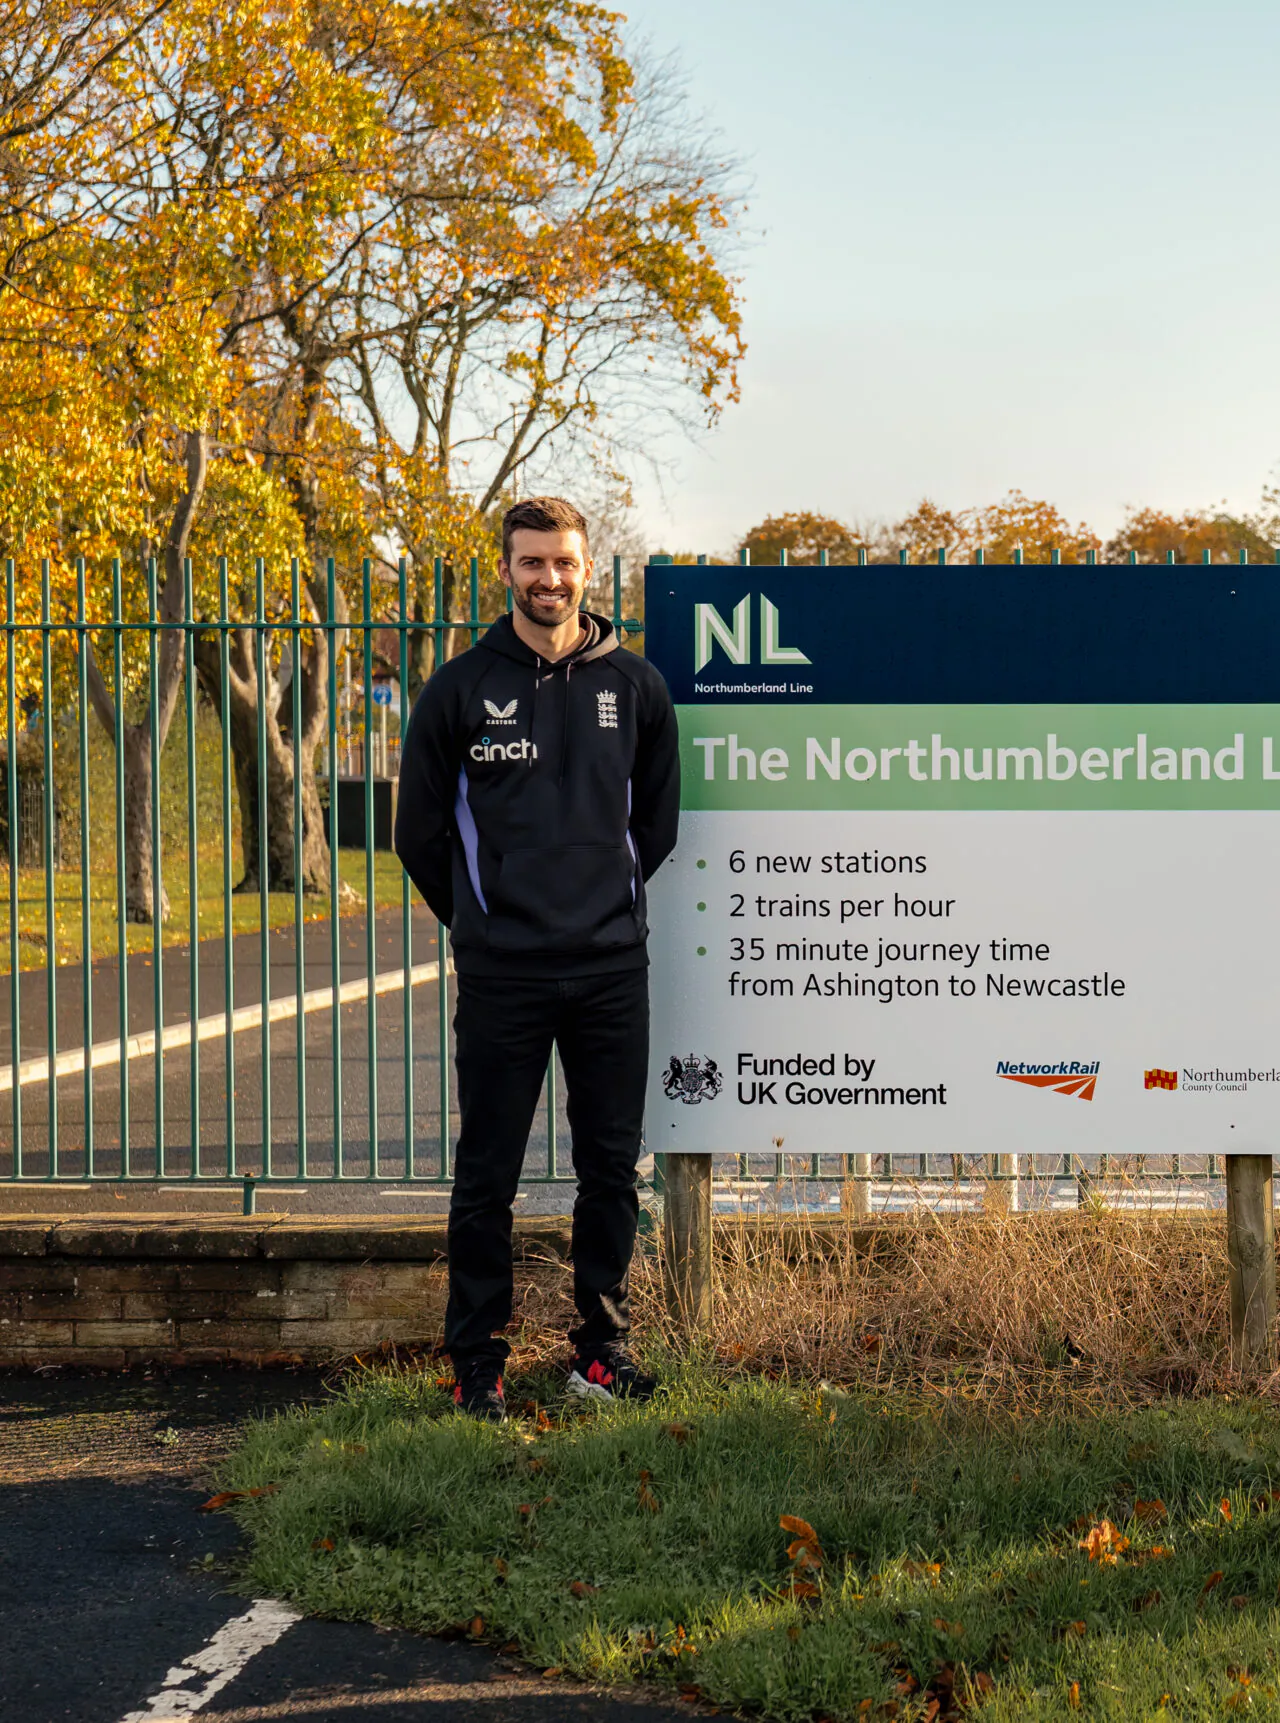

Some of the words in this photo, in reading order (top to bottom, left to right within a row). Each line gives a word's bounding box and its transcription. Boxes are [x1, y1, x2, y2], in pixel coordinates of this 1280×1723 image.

[694, 592, 813, 675] NL
[694, 682, 787, 693] Northumberland
[790, 682, 814, 693] Line
[469, 736, 538, 762] cinch
[693, 734, 790, 781] The
[806, 733, 1244, 781] Northumberland
[729, 850, 746, 874] 6
[756, 855, 812, 874] new
[820, 850, 927, 874] stations
[729, 893, 745, 917] 2
[754, 894, 831, 917] trains
[840, 899, 885, 924] per
[894, 893, 956, 917] hour
[729, 938, 765, 962] 35
[776, 938, 869, 962] minute
[874, 938, 981, 969] journey
[989, 938, 1050, 962] time
[729, 972, 794, 997] from
[803, 972, 939, 1004] Ashington
[948, 976, 976, 997] to
[986, 972, 1126, 997] Newcastle
[737, 1053, 835, 1076] Funded
[844, 1053, 876, 1082] by
[737, 1081, 778, 1105] UK
[785, 1080, 947, 1106] Government
[1182, 1082, 1213, 1093] County
[1214, 1082, 1248, 1092] Council
